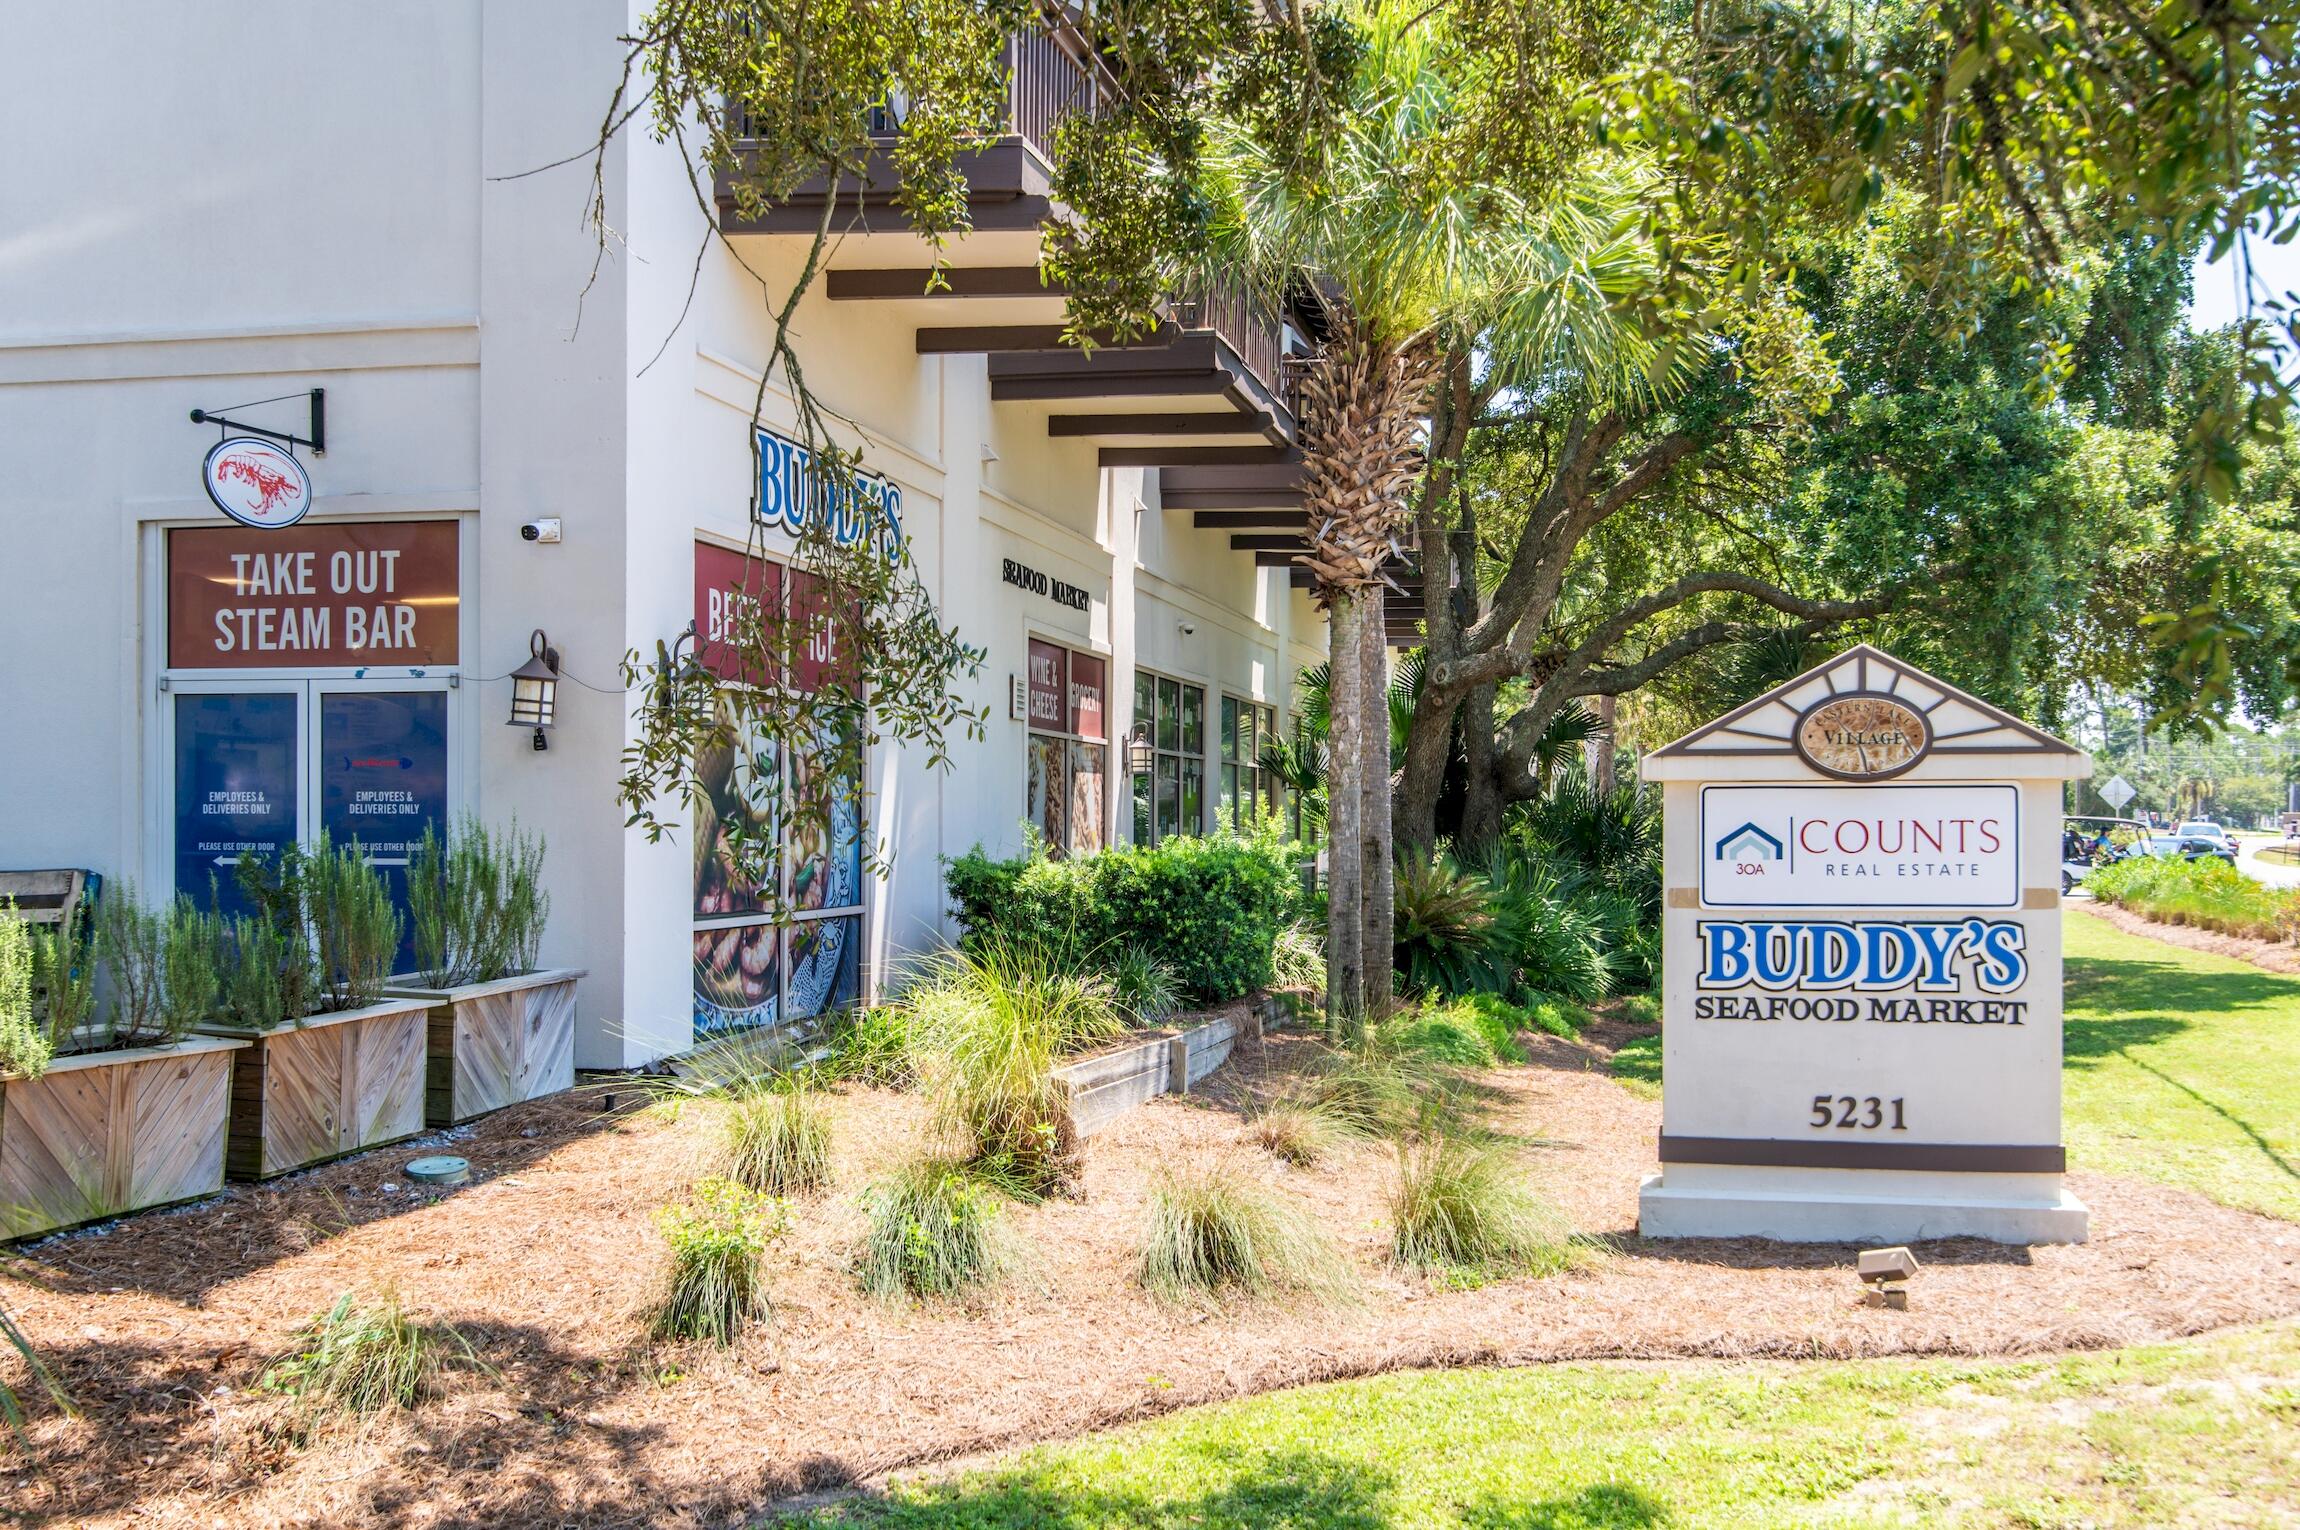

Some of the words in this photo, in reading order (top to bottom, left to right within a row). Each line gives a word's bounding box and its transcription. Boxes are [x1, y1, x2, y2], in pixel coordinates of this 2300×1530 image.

[231, 551, 316, 596] TAKE
[330, 549, 401, 594] OUT
[1002, 557, 1047, 596] SEAFOOD
[1051, 577, 1089, 612] MARKET
[214, 606, 330, 652] STEAM
[345, 605, 417, 650] BAR
[1030, 655, 1050, 686] WINE
[1052, 660, 1058, 688] &
[1030, 689, 1058, 721] CHEESE
[1071, 682, 1100, 713] GROCERY
[1824, 730, 1905, 745] VILLAGE
[202, 803, 249, 815] DELIVERIES
[250, 803, 271, 815] ONLY
[209, 791, 257, 802] EMPLOYEES
[258, 791, 265, 802] &
[349, 803, 397, 815] DELIVERIES
[399, 803, 420, 815] ONLY
[356, 791, 405, 802] EMPLOYEES
[406, 791, 413, 802] &
[198, 842, 221, 851] PLEASE
[223, 842, 235, 851] USE
[236, 842, 256, 851] OTHER
[257, 842, 276, 851] DOOR
[345, 842, 369, 851] PLSE
[370, 842, 383, 851] USE
[383, 842, 405, 851] OTHER
[1800, 819, 2001, 854] COUNTS
[1736, 863, 1765, 875] 30A
[1826, 863, 1880, 876] REAL
[1898, 863, 1980, 876] ESTATE
[1700, 919, 2025, 991] BUDDY'S
[1695, 996, 1859, 1021] SEAFOOD
[1869, 997, 2027, 1025] MARKET
[1809, 1095, 1908, 1130] 5231
